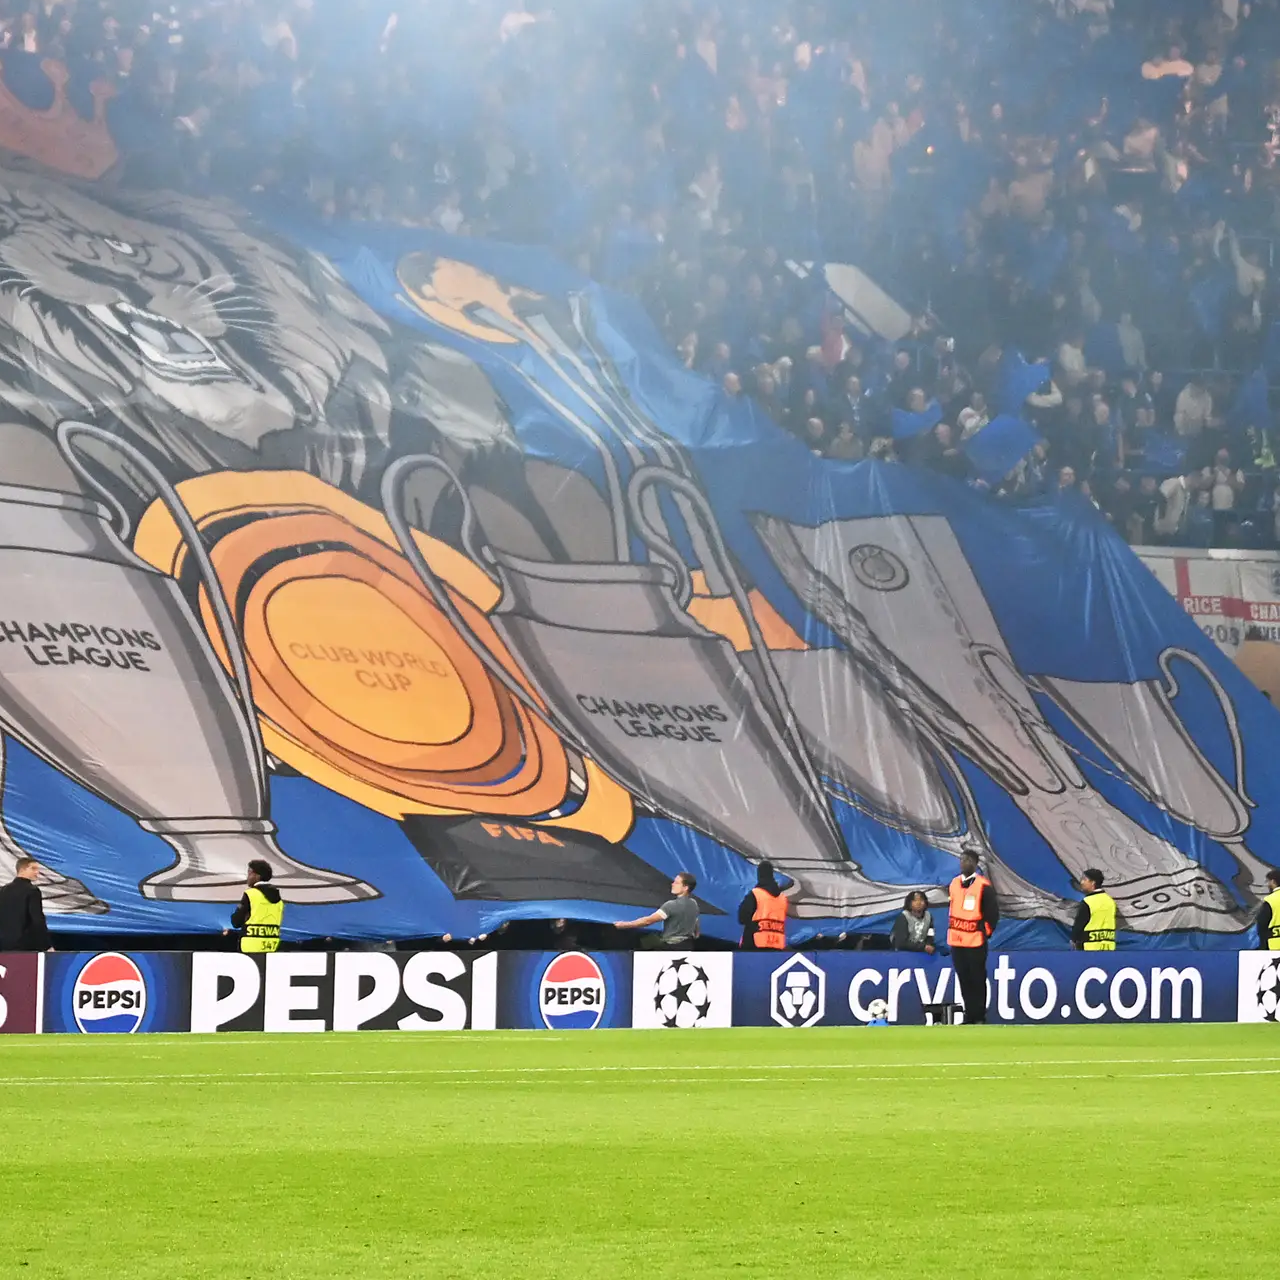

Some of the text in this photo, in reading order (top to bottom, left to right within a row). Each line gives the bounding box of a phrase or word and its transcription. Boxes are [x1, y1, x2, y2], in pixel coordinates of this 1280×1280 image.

[23, 644, 151, 672] LEAGUE
[288, 641, 449, 678] CLUB WORLD
[355, 669, 412, 692] CUP
[576, 694, 728, 723] CHAMPIONS
[613, 718, 723, 744] LEAGUE
[79, 989, 141, 1009] PEPSI
[190, 950, 498, 1032] PEPSI
[544, 986, 601, 1005] PEPSI
